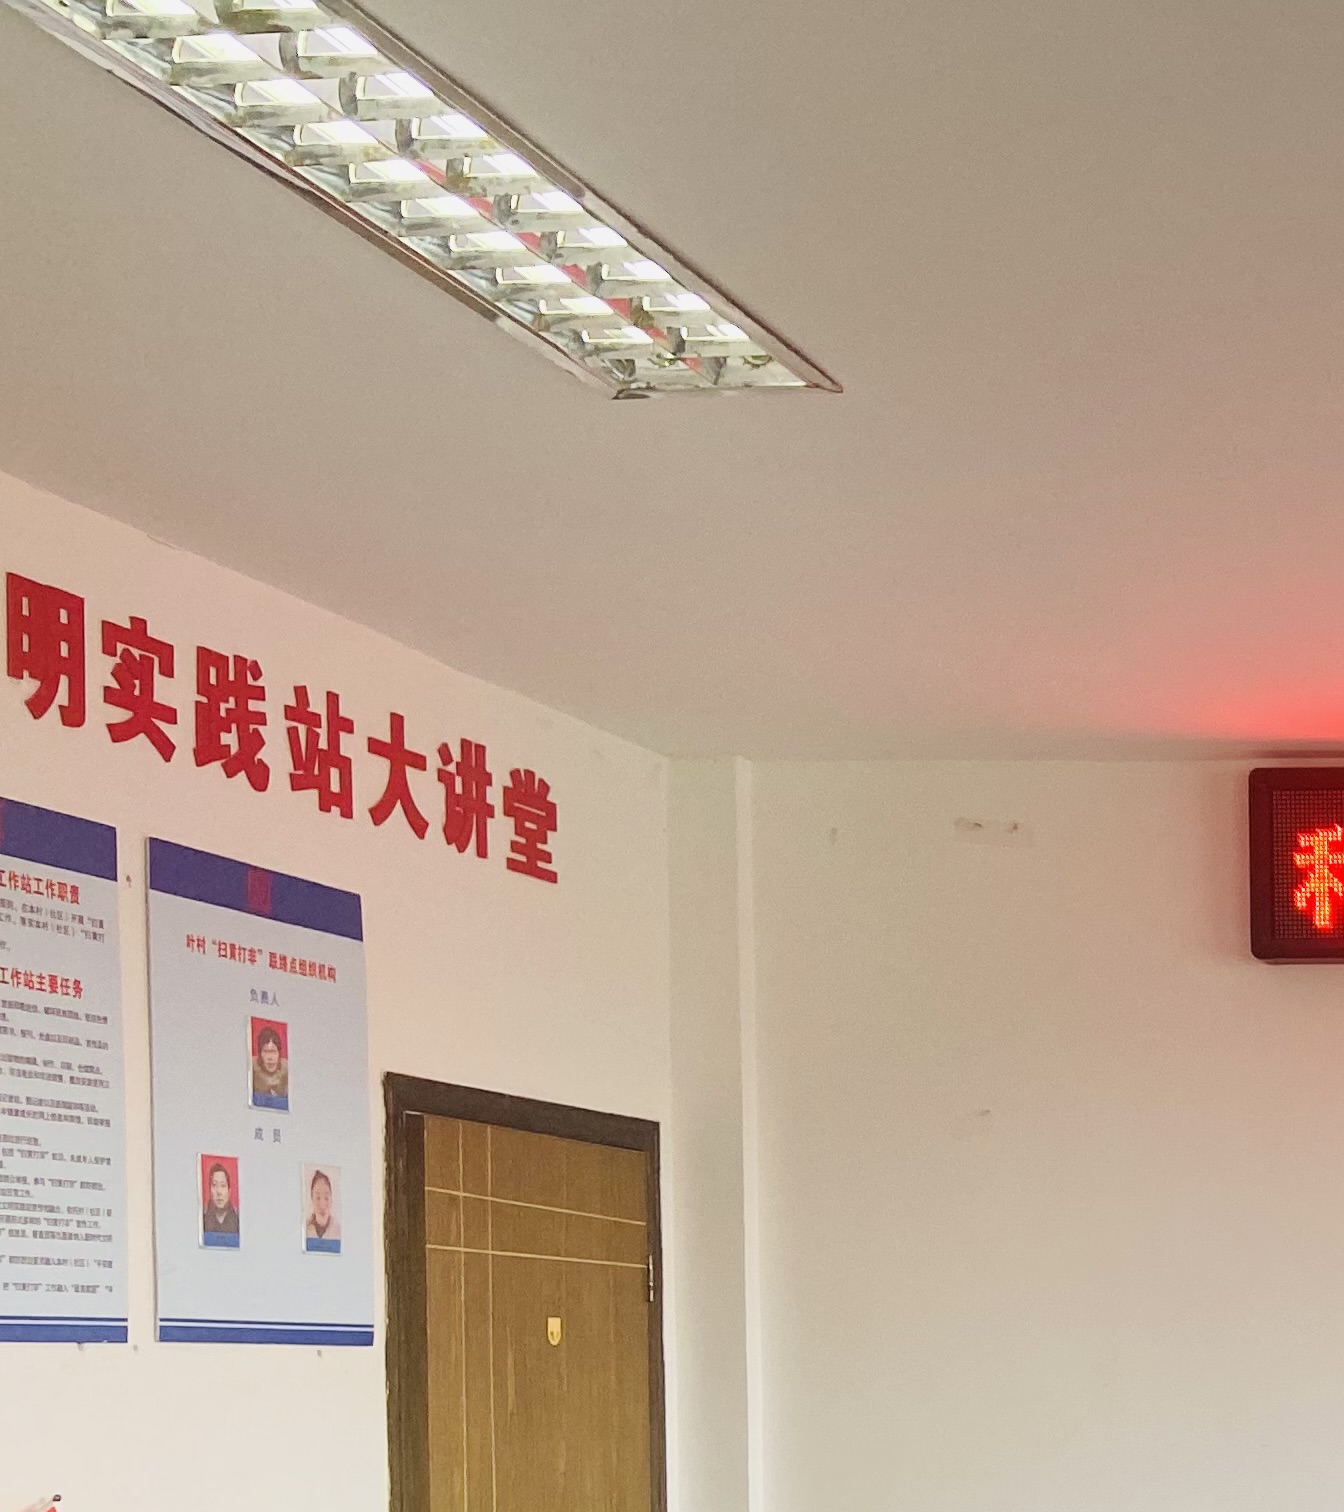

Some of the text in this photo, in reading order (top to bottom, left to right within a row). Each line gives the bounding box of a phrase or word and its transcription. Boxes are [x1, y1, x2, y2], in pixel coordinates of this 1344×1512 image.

[5, 572, 560, 885] 明实践站大讲堂
